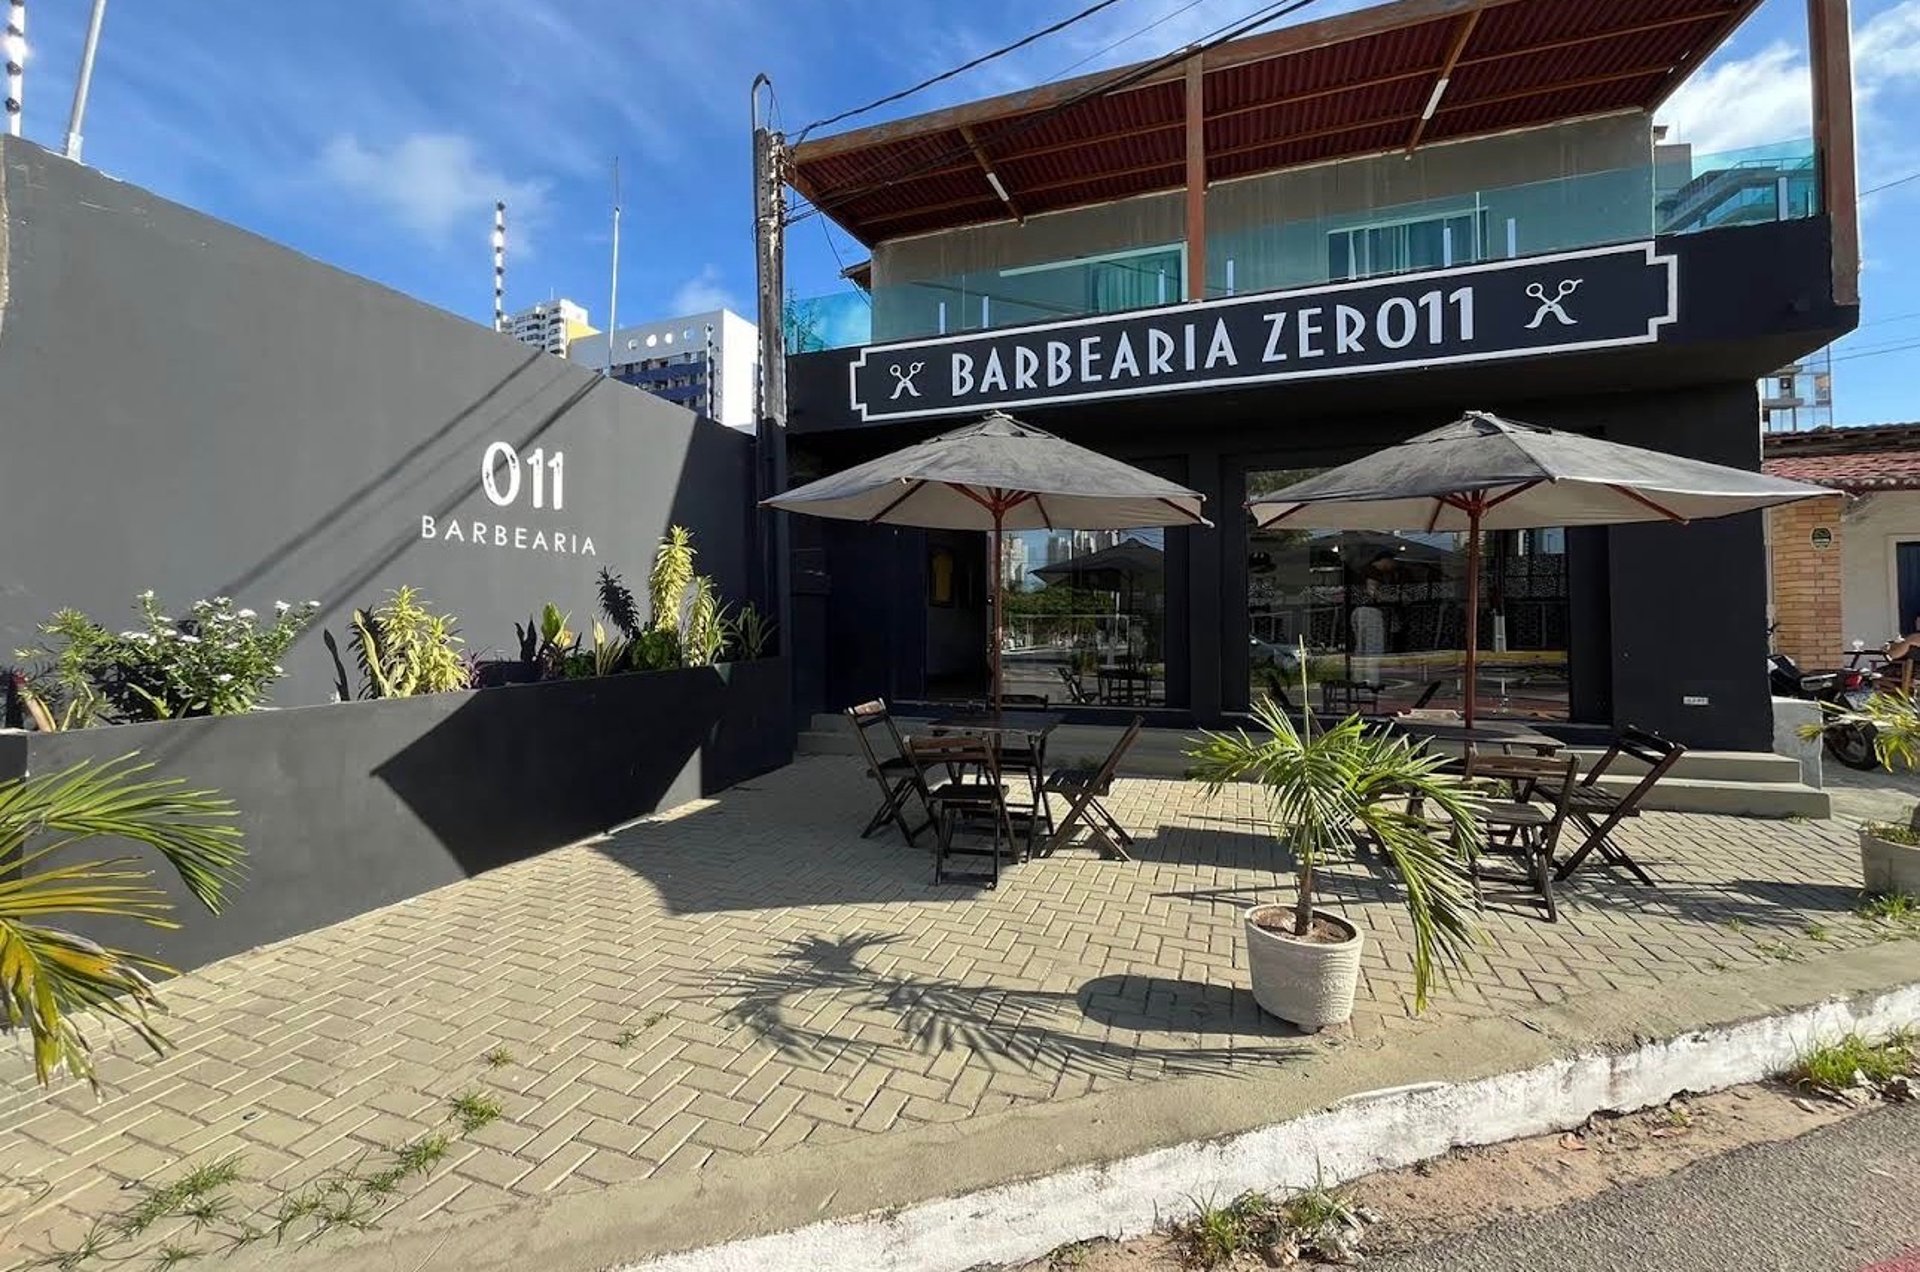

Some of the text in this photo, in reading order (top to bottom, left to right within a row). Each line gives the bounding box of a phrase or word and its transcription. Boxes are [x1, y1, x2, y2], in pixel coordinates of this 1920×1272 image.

[950, 316, 1239, 397] BARBEARIA
[480, 440, 565, 511] 011
[419, 513, 598, 557] BARBEARIA
